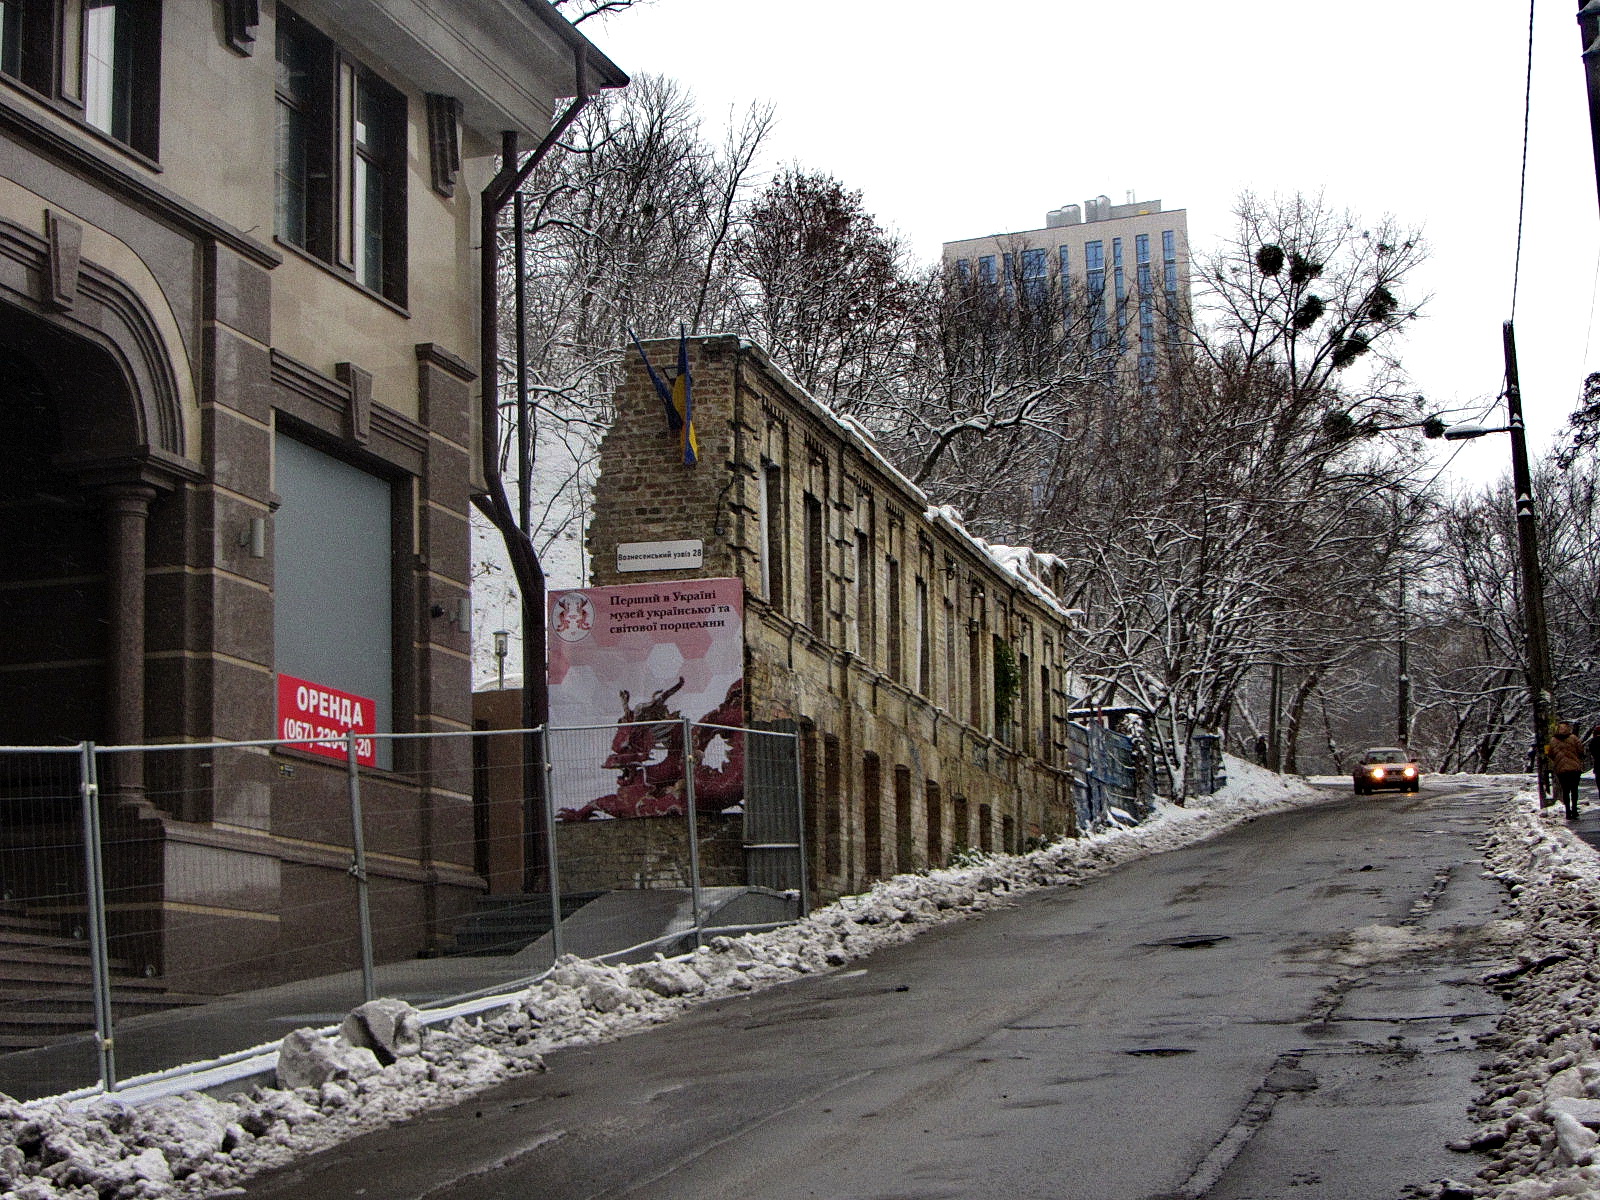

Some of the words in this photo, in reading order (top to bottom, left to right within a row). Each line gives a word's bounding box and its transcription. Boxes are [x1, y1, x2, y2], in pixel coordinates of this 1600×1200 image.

[618, 550, 671, 561] Вознесенський
[673, 551, 691, 560] узвіз
[692, 548, 702, 557] 28
[610, 594, 660, 607] Перший
[663, 595, 670, 603] в
[672, 590, 716, 603] Україні
[609, 608, 644, 621] музей
[646, 605, 715, 620] української
[718, 605, 730, 613] та
[609, 622, 657, 634] світової
[660, 619, 725, 633] порцеляни
[296, 686, 363, 728] ОРЕНДА
[284, 718, 314, 748] (067)
